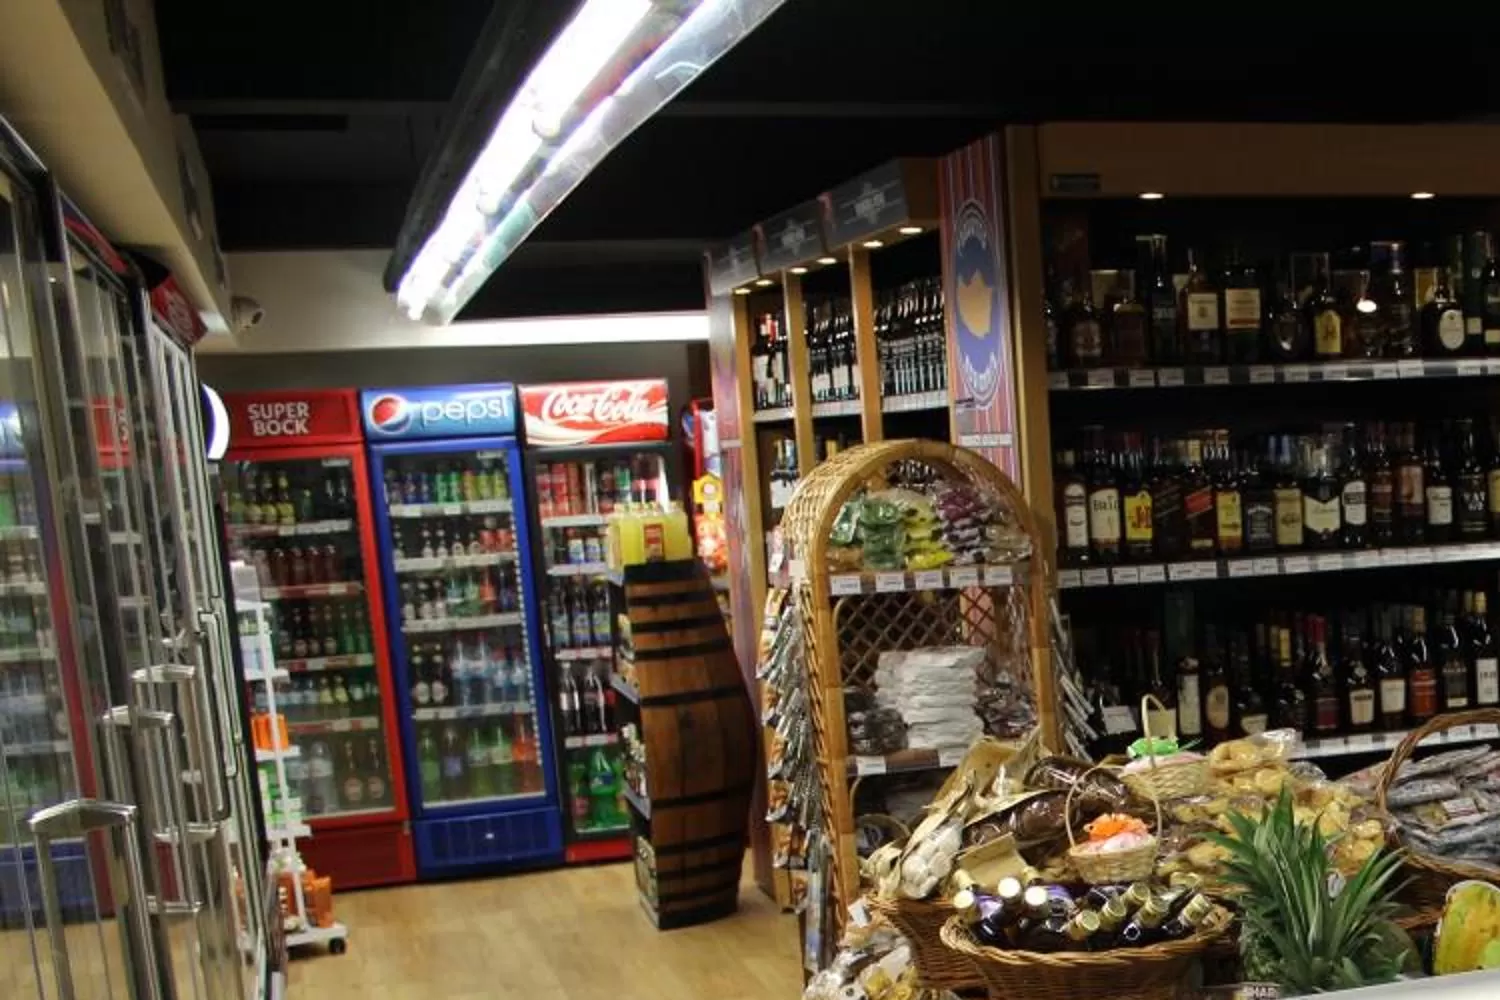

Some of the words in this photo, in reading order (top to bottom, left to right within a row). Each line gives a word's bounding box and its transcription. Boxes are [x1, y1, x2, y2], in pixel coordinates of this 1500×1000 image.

[247, 403, 310, 421] SUPER
[421, 393, 511, 426] pepsi
[541, 386, 648, 424] Coca-Cola
[254, 418, 310, 436] BOCK
